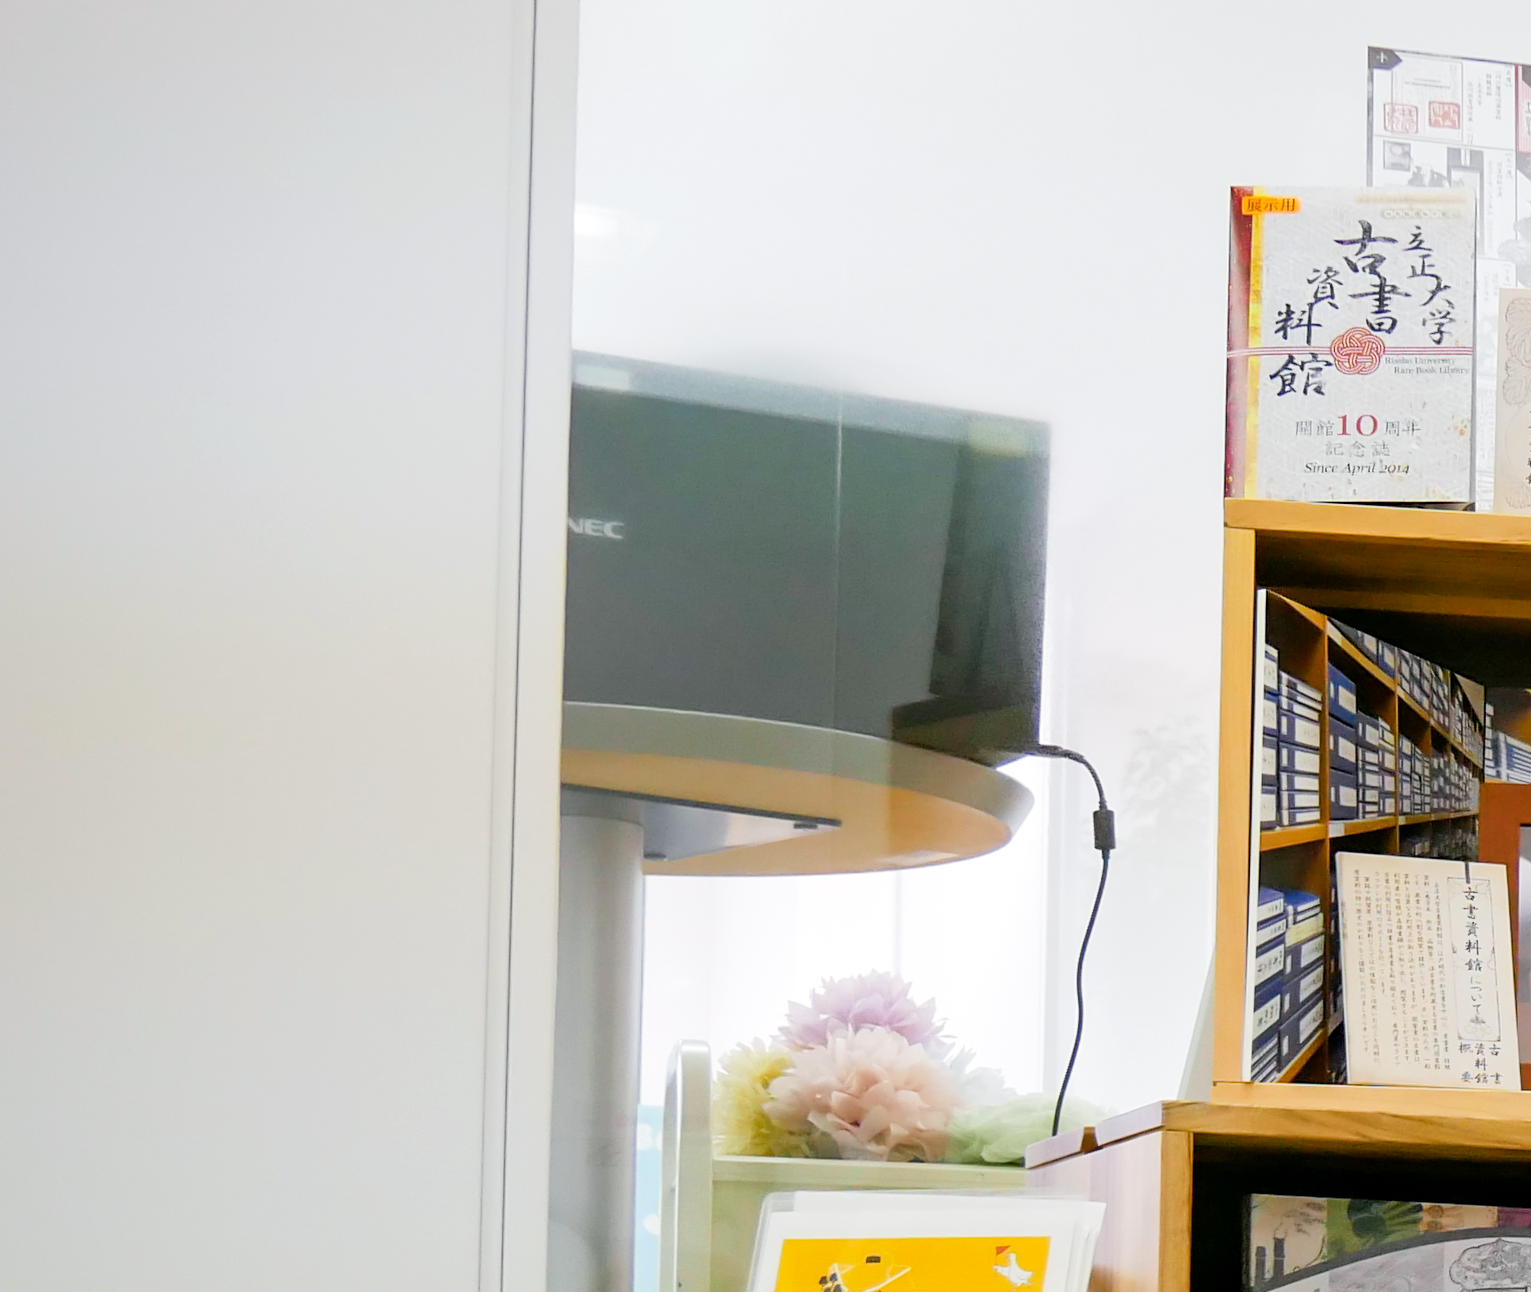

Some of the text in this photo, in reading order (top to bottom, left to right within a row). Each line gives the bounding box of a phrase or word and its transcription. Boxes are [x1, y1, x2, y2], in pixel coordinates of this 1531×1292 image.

[1246, 197, 1297, 213] 展示用
[1335, 221, 1410, 334] 古書
[1402, 225, 1456, 345] 立正大学
[1269, 267, 1344, 396] 資料館
[1295, 414, 1421, 438] 開館10周年
[1325, 440, 1391, 458] 記念誌
[1303, 462, 1411, 477] Since April 2014
[568, 518, 624, 539] NEC
[1462, 886, 1485, 1015] 古書資料館について
